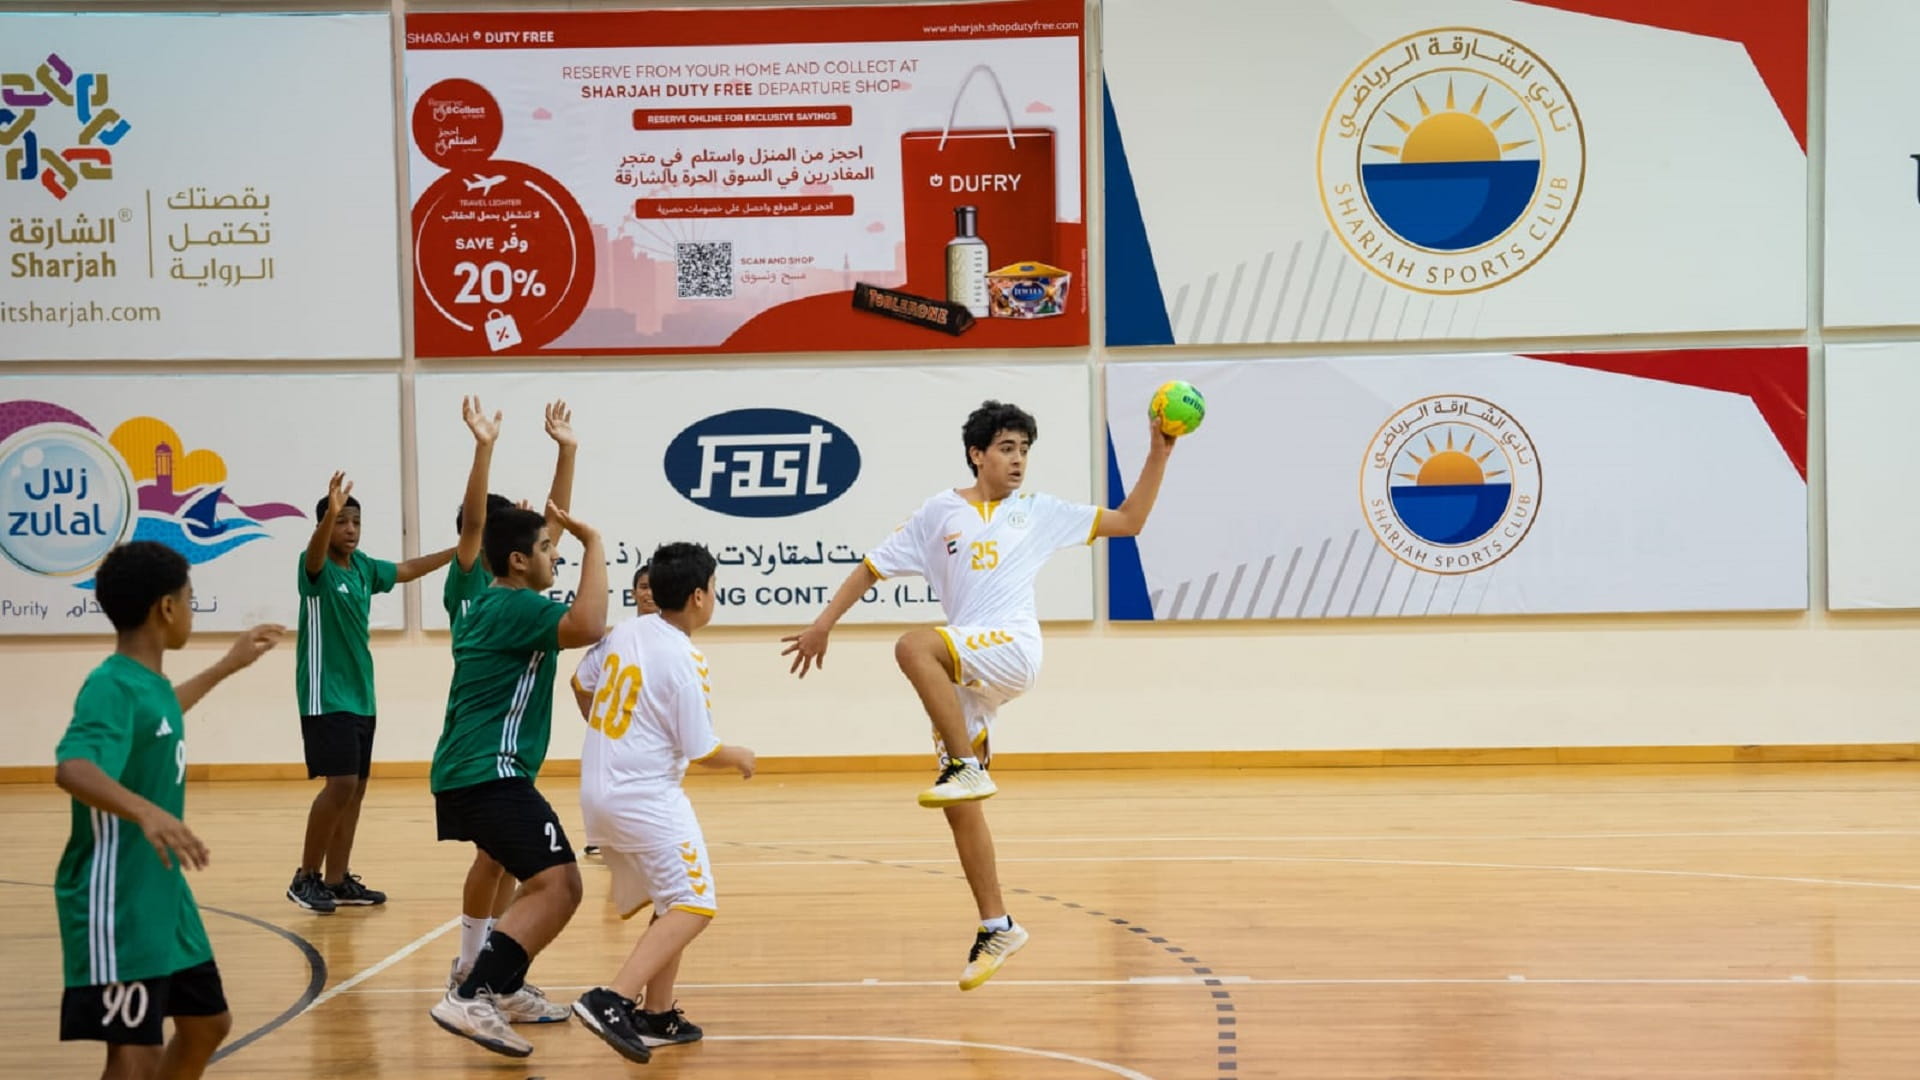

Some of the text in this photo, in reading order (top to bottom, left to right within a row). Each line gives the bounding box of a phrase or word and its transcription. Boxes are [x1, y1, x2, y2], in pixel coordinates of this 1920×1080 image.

[407, 31, 555, 44] SHARJAH DUTY FREE
[923, 21, 1079, 35] www.sharjah.shopdutyfree.com
[562, 58, 919, 79] RESERVE FROM YOUR HOME AND COLLECT AT
[581, 79, 901, 98] SHARJAH DUTY FREE DEPARTURE SHOP
[1338, 36, 1572, 139] نادي الشارقة الرياضي
[647, 112, 838, 124] RESERVE ONLINE FOR EXCLUSIVE SAVINGS
[620, 152, 655, 168] متجر
[660, 150, 683, 169] في
[691, 149, 744, 168] واستلم
[749, 147, 796, 166] المنزل
[801, 147, 823, 164] من
[614, 165, 875, 189] المغادرين في السوق الحرة بالشارقة
[950, 174, 1022, 193] DUFRY
[167, 187, 271, 217] بقصتك
[9, 213, 116, 251] الشارقة
[168, 221, 271, 252] تكتمل
[455, 236, 495, 250] SAVE
[1335, 177, 1569, 284] SHARJAH SPORTS CLUB
[10, 252, 117, 283] Sharjah
[169, 257, 274, 287] الرواية
[740, 256, 814, 265] SCAN AND SHOP
[453, 261, 546, 304] 20%
[1, 301, 161, 328] itsharjah.com
[1434, 400, 1507, 430] الشارقة
[25, 467, 88, 501] زلال
[8, 504, 107, 537] zulal
[1372, 494, 1532, 568] SHARJAH SPORTS CLUB
[969, 540, 999, 571] 25
[2, 599, 48, 620] Purity
[755, 586, 832, 606] CONT.
[588, 652, 643, 740] 20
[545, 821, 562, 853] 2
[101, 982, 149, 1028] 90
